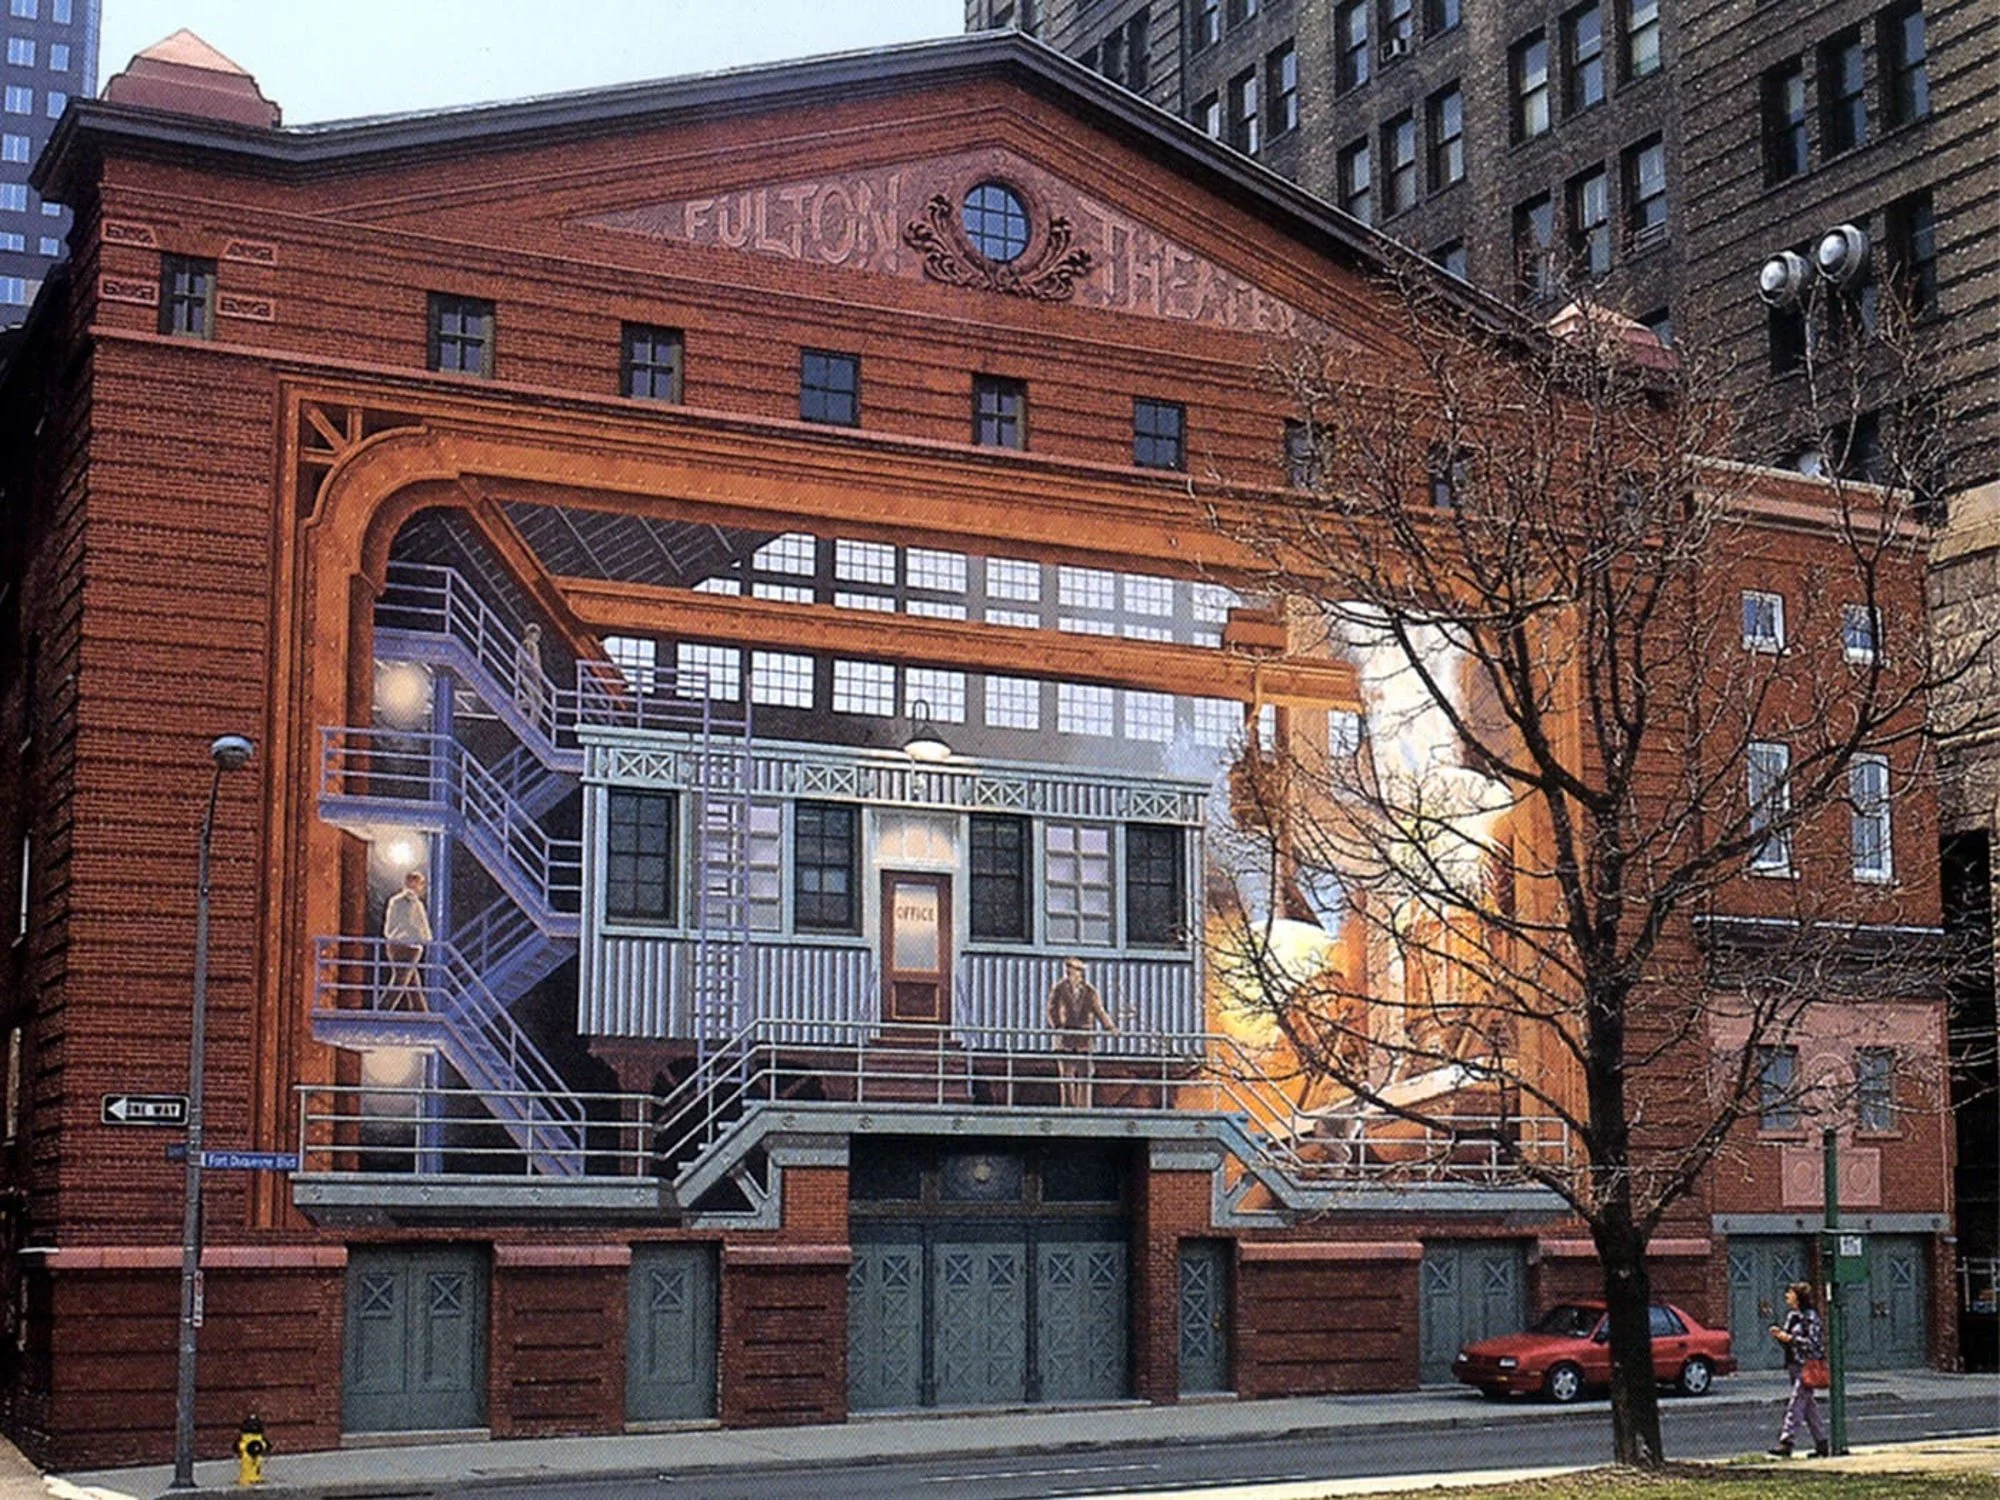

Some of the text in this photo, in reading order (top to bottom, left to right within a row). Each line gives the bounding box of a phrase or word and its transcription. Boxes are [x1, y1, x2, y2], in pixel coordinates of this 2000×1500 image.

[684, 172, 899, 272] FULTON
[897, 906, 934, 921] OFFICE
[126, 1103, 178, 1117] ONE WAY
[208, 1154, 297, 1168] Fort Duquesne Blvd
